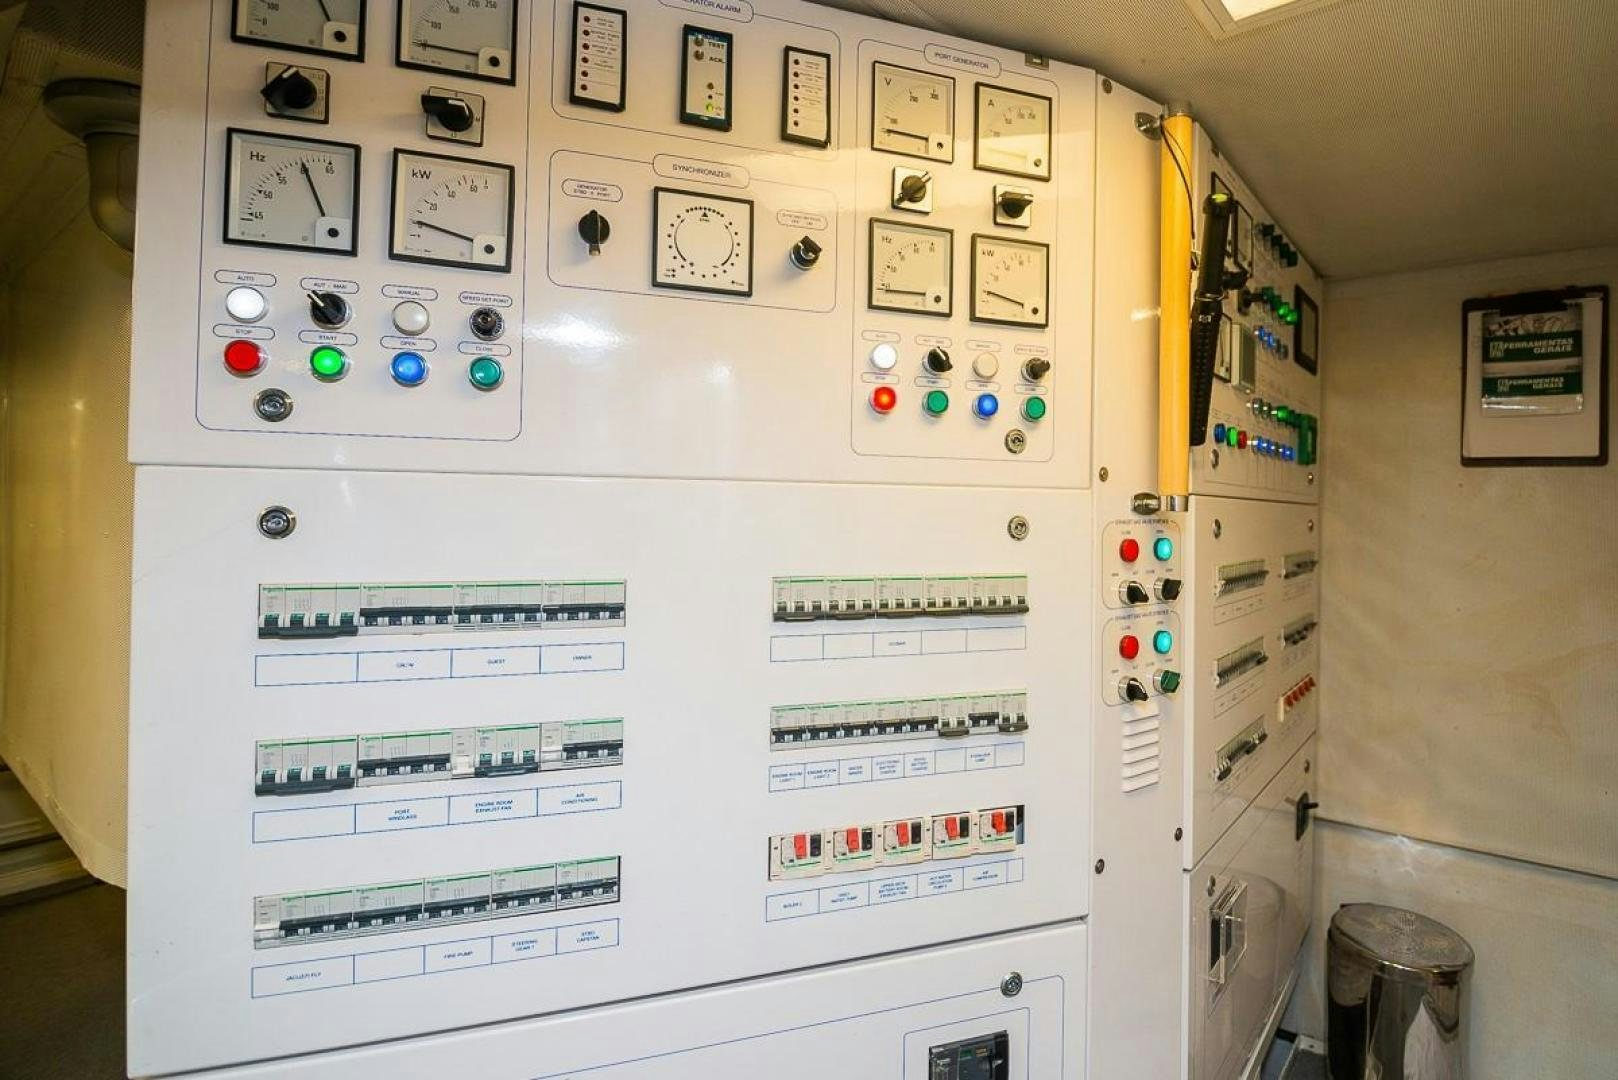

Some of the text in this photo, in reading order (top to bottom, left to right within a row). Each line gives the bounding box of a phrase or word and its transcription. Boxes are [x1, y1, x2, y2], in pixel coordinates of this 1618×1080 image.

[716, 3, 741, 13] ALARM
[430, 21, 442, 30] 100
[885, 77, 892, 86] V
[988, 99, 994, 107] A
[250, 151, 266, 162] Hz
[412, 169, 431, 180] kW
[672, 163, 730, 179] SYNCHRONIZER
[278, 177, 287, 185] 55
[263, 191, 273, 199] 50
[429, 203, 437, 211] 20
[254, 212, 263, 220] 45
[881, 235, 892, 243] Hz
[982, 249, 995, 257] kW
[1503, 337, 1574, 350] FERRAMENTAS
[1533, 344, 1572, 355] GERAIS
